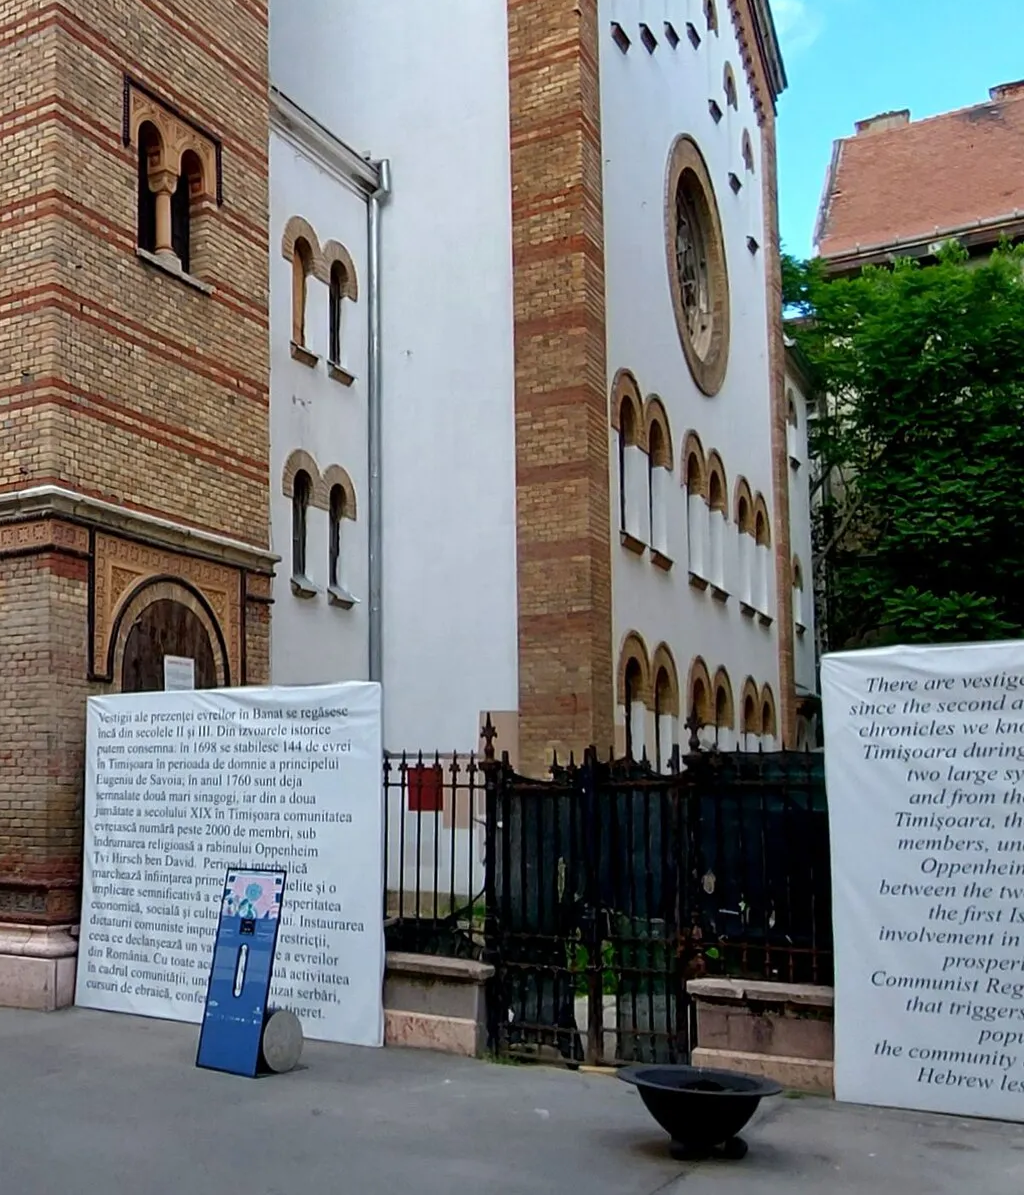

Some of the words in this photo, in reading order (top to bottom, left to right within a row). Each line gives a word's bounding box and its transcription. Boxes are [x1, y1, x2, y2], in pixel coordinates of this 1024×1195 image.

[866, 677, 918, 693] There
[924, 678, 954, 690] are
[849, 701, 896, 716] since
[902, 698, 931, 714] the
[936, 694, 1006, 713] second
[134, 711, 148, 722] ale
[197, 708, 235, 721] evreilor
[253, 708, 283, 719] Banat
[286, 710, 297, 719] se
[118, 727, 133, 738] din
[136, 726, 173, 738] secolele
[176, 726, 184, 737] II
[217, 725, 235, 736] Din
[239, 724, 287, 736] izvoarele
[291, 724, 331, 735] istorice
[859, 720, 955, 738] chronicles
[963, 722, 988, 735] we
[97, 746, 125, 756] putem
[193, 742, 216, 753] 1698
[220, 744, 230, 753] se
[234, 741, 279, 753] stabilesc
[283, 740, 301, 752] 144
[306, 740, 318, 752] de
[322, 739, 351, 752] evrei
[168, 758, 210, 771] perioada
[213, 758, 226, 769] de
[228, 758, 267, 770] domnie
[270, 761, 276, 770] a
[279, 757, 339, 773] principelui
[96, 774, 133, 787] Eugeniu
[136, 774, 147, 785] de
[201, 774, 222, 785] anul
[227, 774, 251, 786] 1760
[254, 776, 276, 786] sunt
[280, 775, 302, 789] deja
[907, 768, 940, 782] two
[947, 766, 998, 785] large
[96, 790, 140, 801] semnalate
[169, 791, 190, 801] mari
[243, 792, 256, 803] iar
[260, 791, 276, 804] din
[280, 795, 285, 804] a
[289, 792, 316, 804] doua
[909, 788, 946, 805] and
[947, 788, 996, 808] from
[136, 809, 141, 817] a
[144, 806, 187, 818] secolului
[190, 807, 212, 819] XIX
[283, 810, 352, 822] comunitatea
[1004, 811, 1024, 828] th
[178, 825, 202, 836] peste
[205, 824, 230, 836] 2000
[233, 825, 245, 836] de
[249, 826, 293, 840] membri,
[297, 827, 316, 839] sub
[206, 840, 251, 854] rabinului
[255, 842, 318, 858] Oppenheim
[898, 835, 989, 852] members,
[112, 853, 142, 864] Hirsch
[145, 854, 161, 866] ben
[92, 884, 134, 897] implicare
[204, 894, 209, 902] a
[879, 879, 956, 897] between
[963, 882, 992, 898] the
[1000, 885, 1024, 899] tw
[90, 914, 131, 928] dictaturii
[134, 920, 183, 932] comuniste
[300, 915, 364, 931] Instaurarea
[928, 904, 958, 921] the
[959, 905, 1002, 925] first
[878, 926, 994, 946] involvement
[1002, 931, 1019, 946] in
[89, 932, 109, 941] ceea
[112, 935, 123, 943] ce
[185, 942, 197, 950] un
[294, 952, 338, 966] evreilor
[88, 947, 102, 957] din
[153, 953, 167, 965] Cu
[171, 957, 195, 967] toate
[290, 969, 349, 986] activitatea
[98, 965, 128, 977] cadrul
[86, 980, 118, 992] cursuri
[120, 983, 132, 993] de
[871, 970, 979, 993] Communist
[986, 977, 1024, 999] Reg
[906, 996, 943, 1014] that
[874, 1039, 902, 1056] the
[908, 1050, 1017, 1071] community
[917, 1067, 993, 1089] Hebrew
